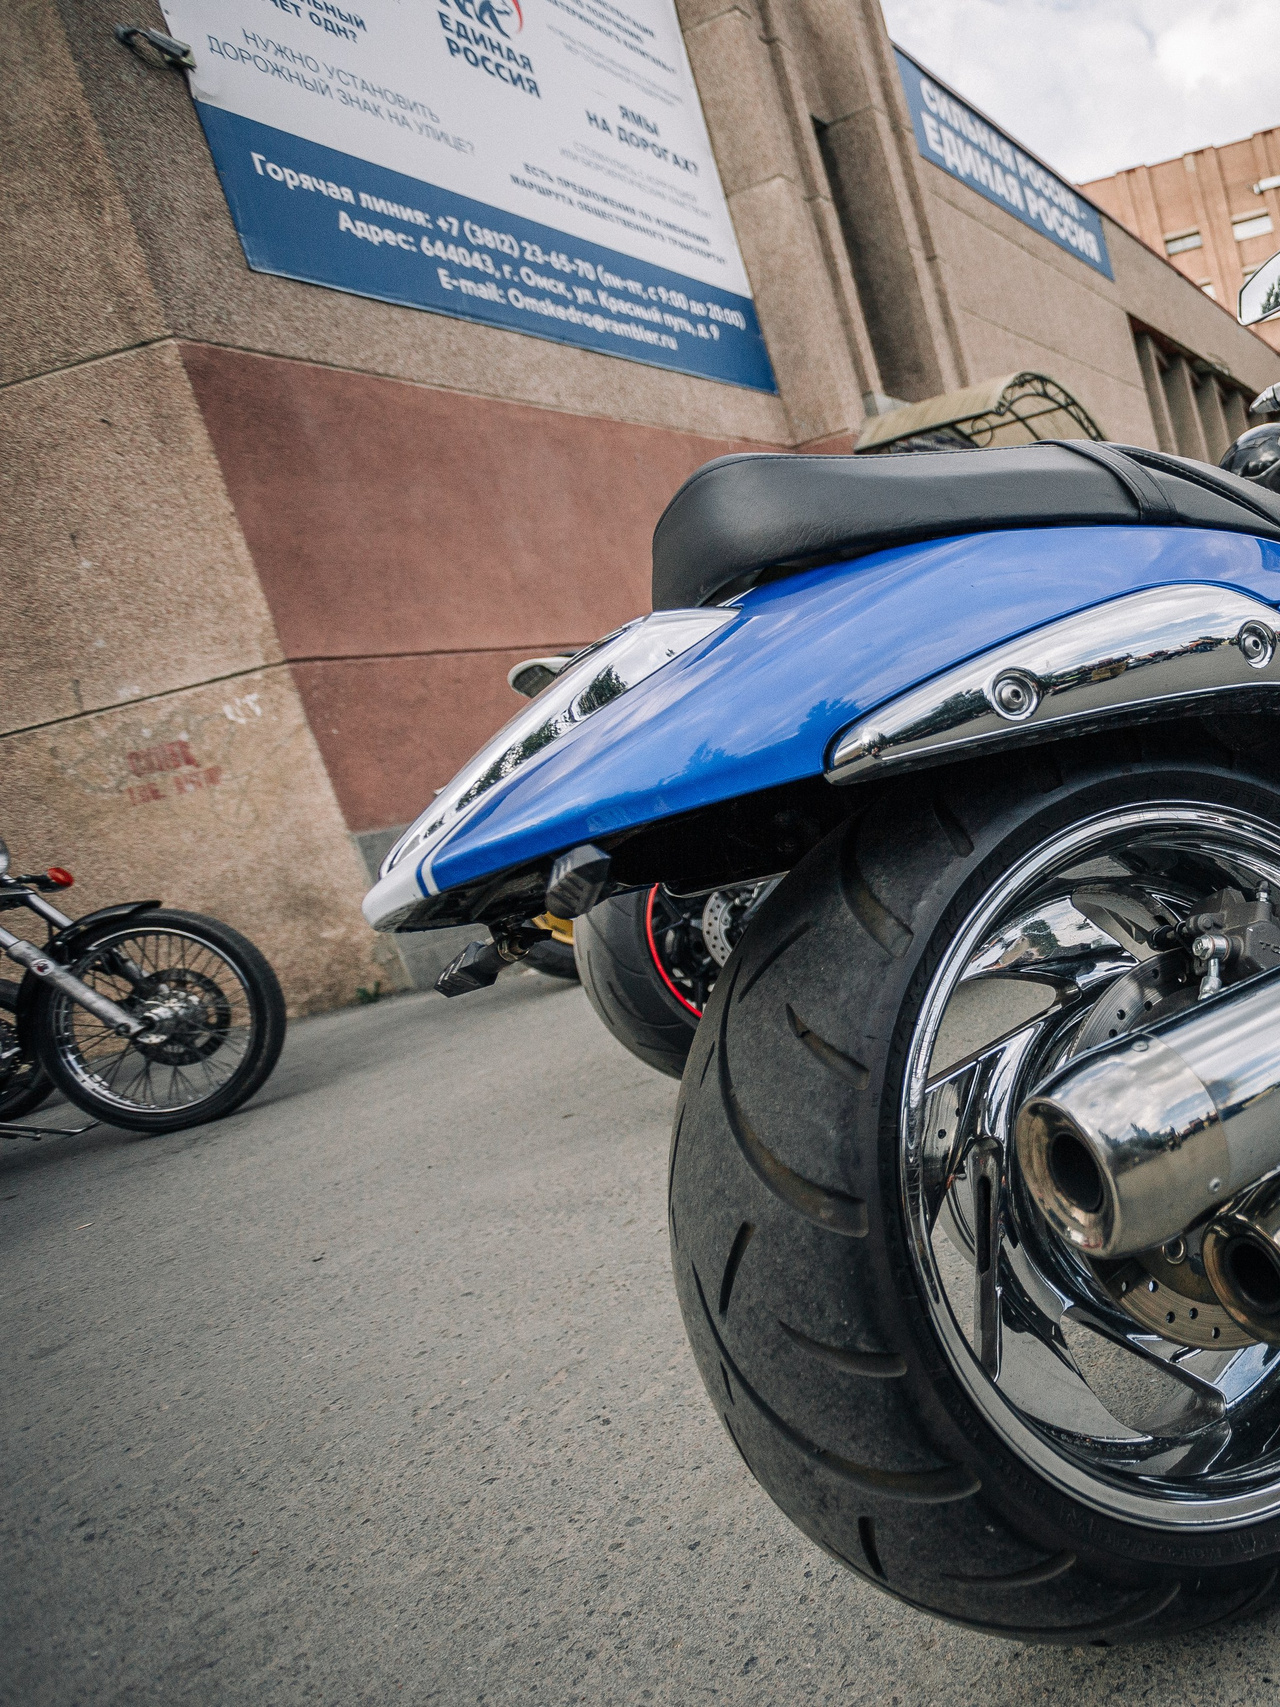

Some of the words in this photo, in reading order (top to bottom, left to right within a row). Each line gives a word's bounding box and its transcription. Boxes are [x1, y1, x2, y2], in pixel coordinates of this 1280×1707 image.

[309, 11, 358, 43] ОДН?
[438, 10, 533, 73] ЕДИНАЯ
[206, 34, 333, 100] ДОРОЖНЫЙ
[336, 88, 384, 121] ЗНАК
[386, 108, 413, 132] НА
[413, 119, 475, 155] УЛИЦЕ?
[241, 27, 319, 73] НУЖНО
[321, 62, 440, 123] УСТАНОВИТЬ
[445, 37, 541, 99] РОССИЯ
[585, 109, 612, 136] НА
[617, 126, 699, 176] ДОРОГАХ?
[618, 105, 660, 138] ЯМЫ
[919, 78, 1017, 172] СИЛЬНАЯ
[1014, 150, 1080, 220] РОССИЯ
[509, 173, 575, 207] МАРШРУТА
[523, 162, 554, 182] ЕСТЬ
[556, 176, 636, 216] ПРЕДЛОЖЕНИЯ
[920, 111, 1026, 213] ЕДИНАЯ
[1023, 186, 1102, 264] РОССИЯ
[250, 151, 356, 206] Горячая
[359, 191, 434, 230] линия:
[436, 215, 460, 238] +7
[463, 219, 520, 259] (3812)
[520, 240, 596, 282] 23-65-70
[657, 285, 689, 311] 9:00
[706, 301, 746, 331] 20:00)
[338, 210, 418, 252] Адрес:
[420, 235, 502, 280] 644043,
[502, 263, 519, 281] г.
[519, 265, 574, 301] Омск,
[571, 285, 598, 304] ул.
[596, 288, 664, 325] Красный
[663, 312, 698, 337] путь,
[709, 323, 720, 342] 9
[437, 267, 507, 305] E-mail:
[507, 288, 679, 351] Omskedro@rambler.ru
